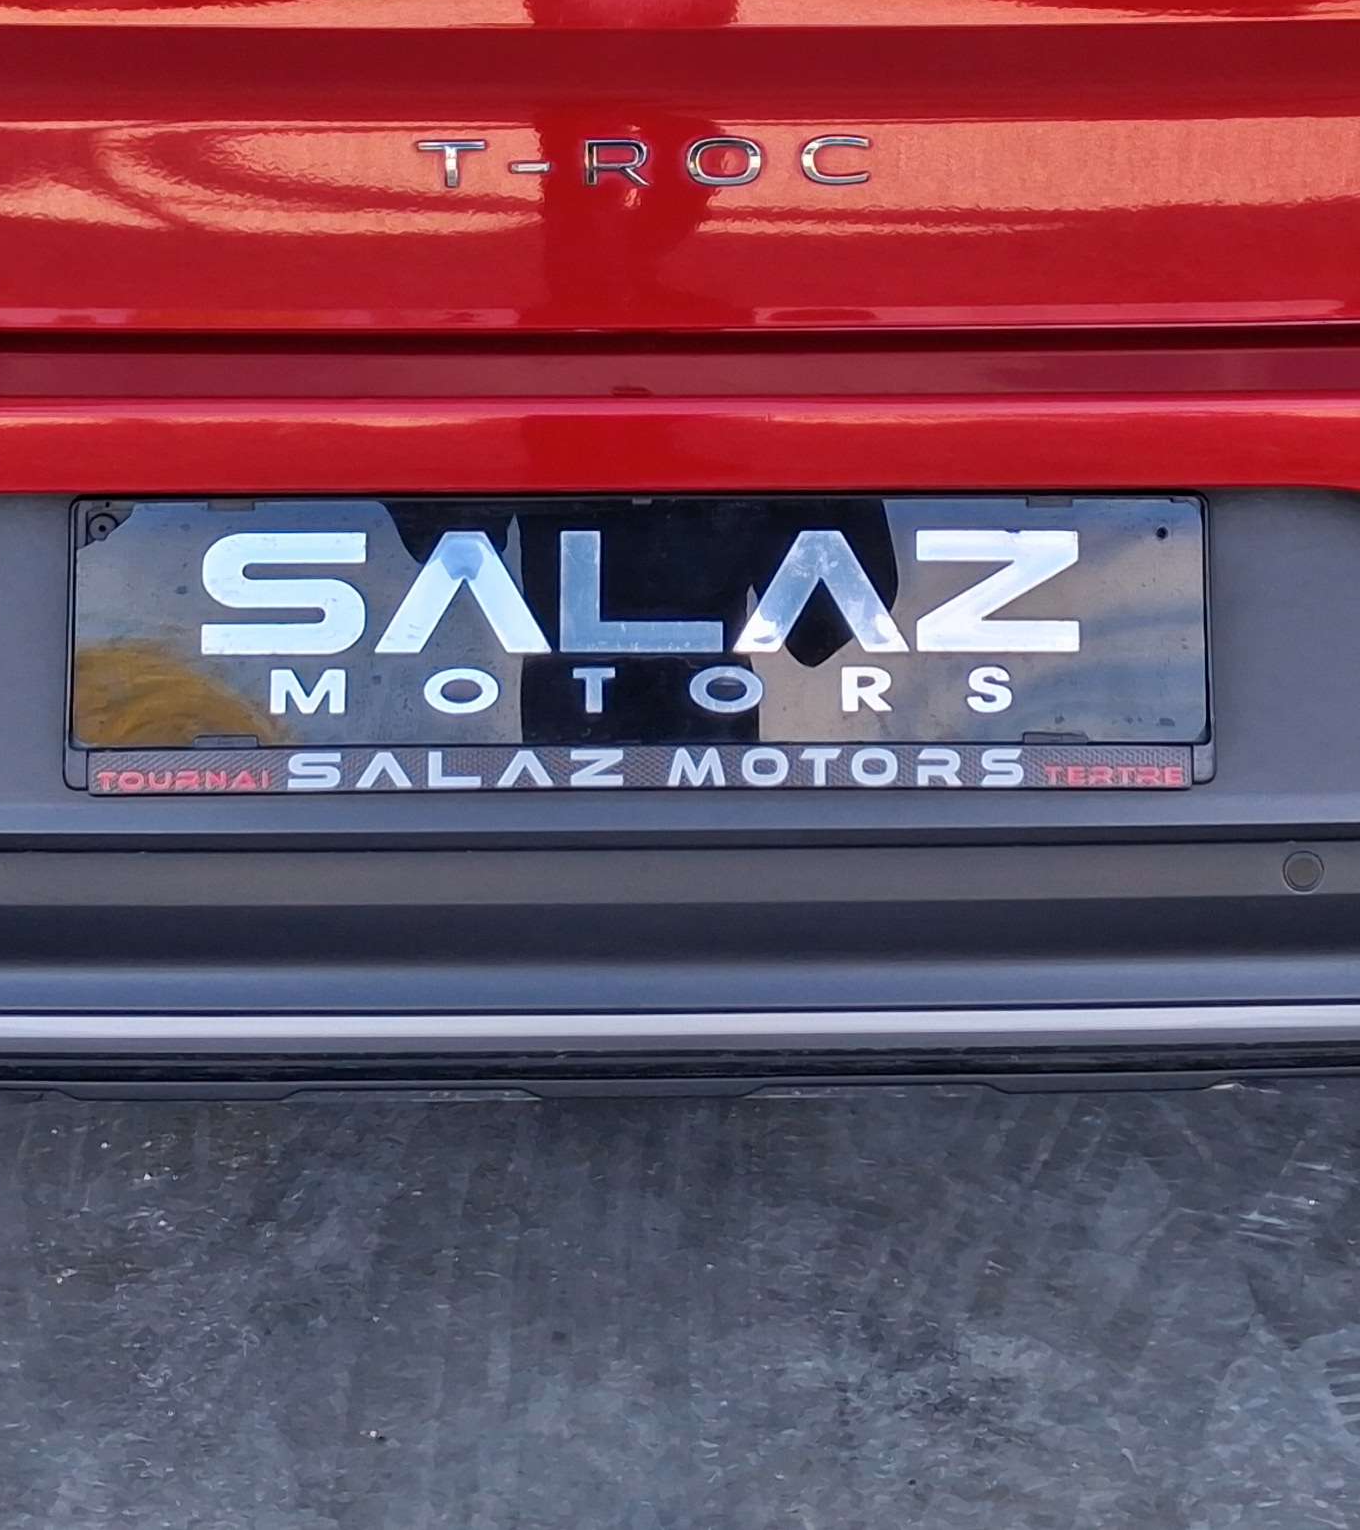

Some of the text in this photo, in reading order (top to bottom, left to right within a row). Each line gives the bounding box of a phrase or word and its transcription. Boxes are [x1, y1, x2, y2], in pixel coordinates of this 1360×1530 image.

[416, 135, 871, 188] T-ROC
[200, 530, 1080, 655] SALAZ
[269, 666, 1014, 714] MOTORS
[96, 747, 1186, 791] TOURNAI SALAZ MOTORS TERTRE
